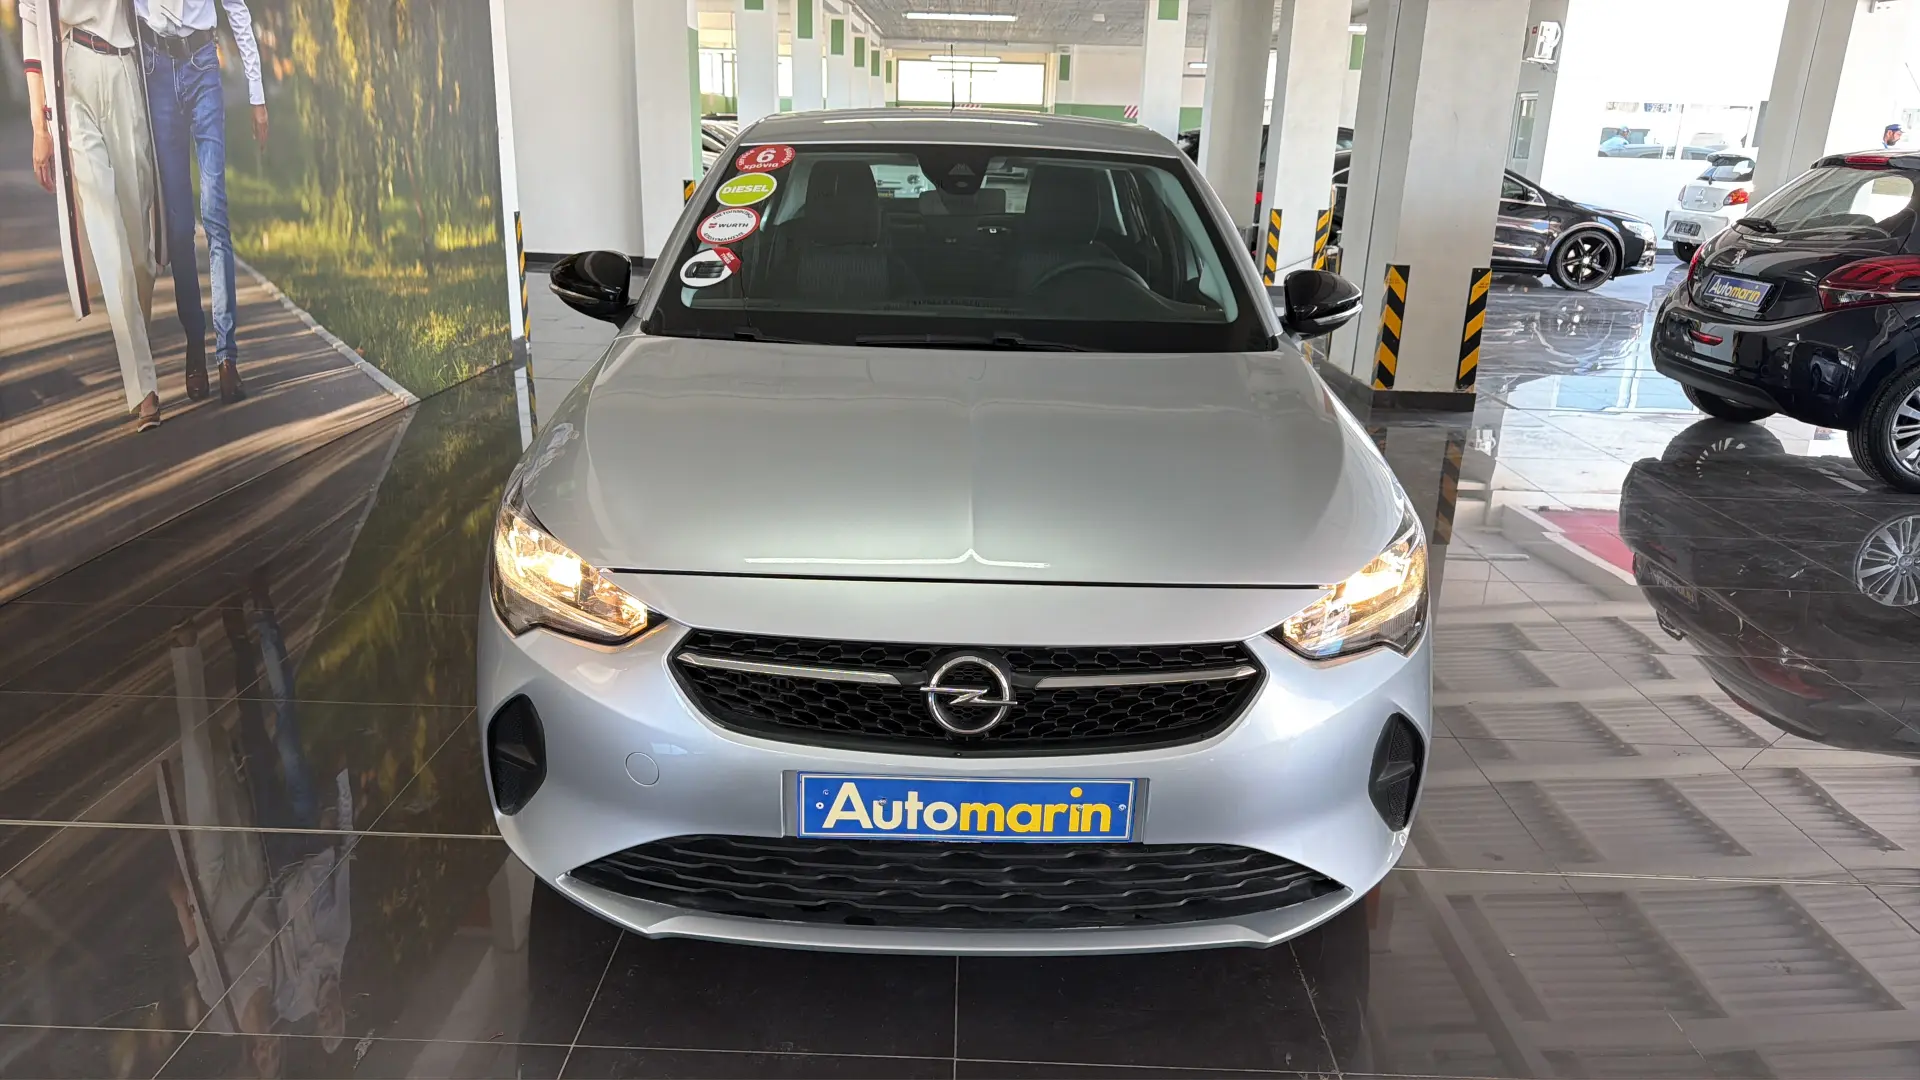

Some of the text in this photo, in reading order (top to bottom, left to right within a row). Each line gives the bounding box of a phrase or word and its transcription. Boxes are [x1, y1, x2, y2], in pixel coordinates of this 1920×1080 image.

[756, 149, 777, 163] 6
[721, 185, 769, 194] DIESEL
[1708, 278, 1760, 302] Automarin
[822, 782, 1111, 832] Automarin
